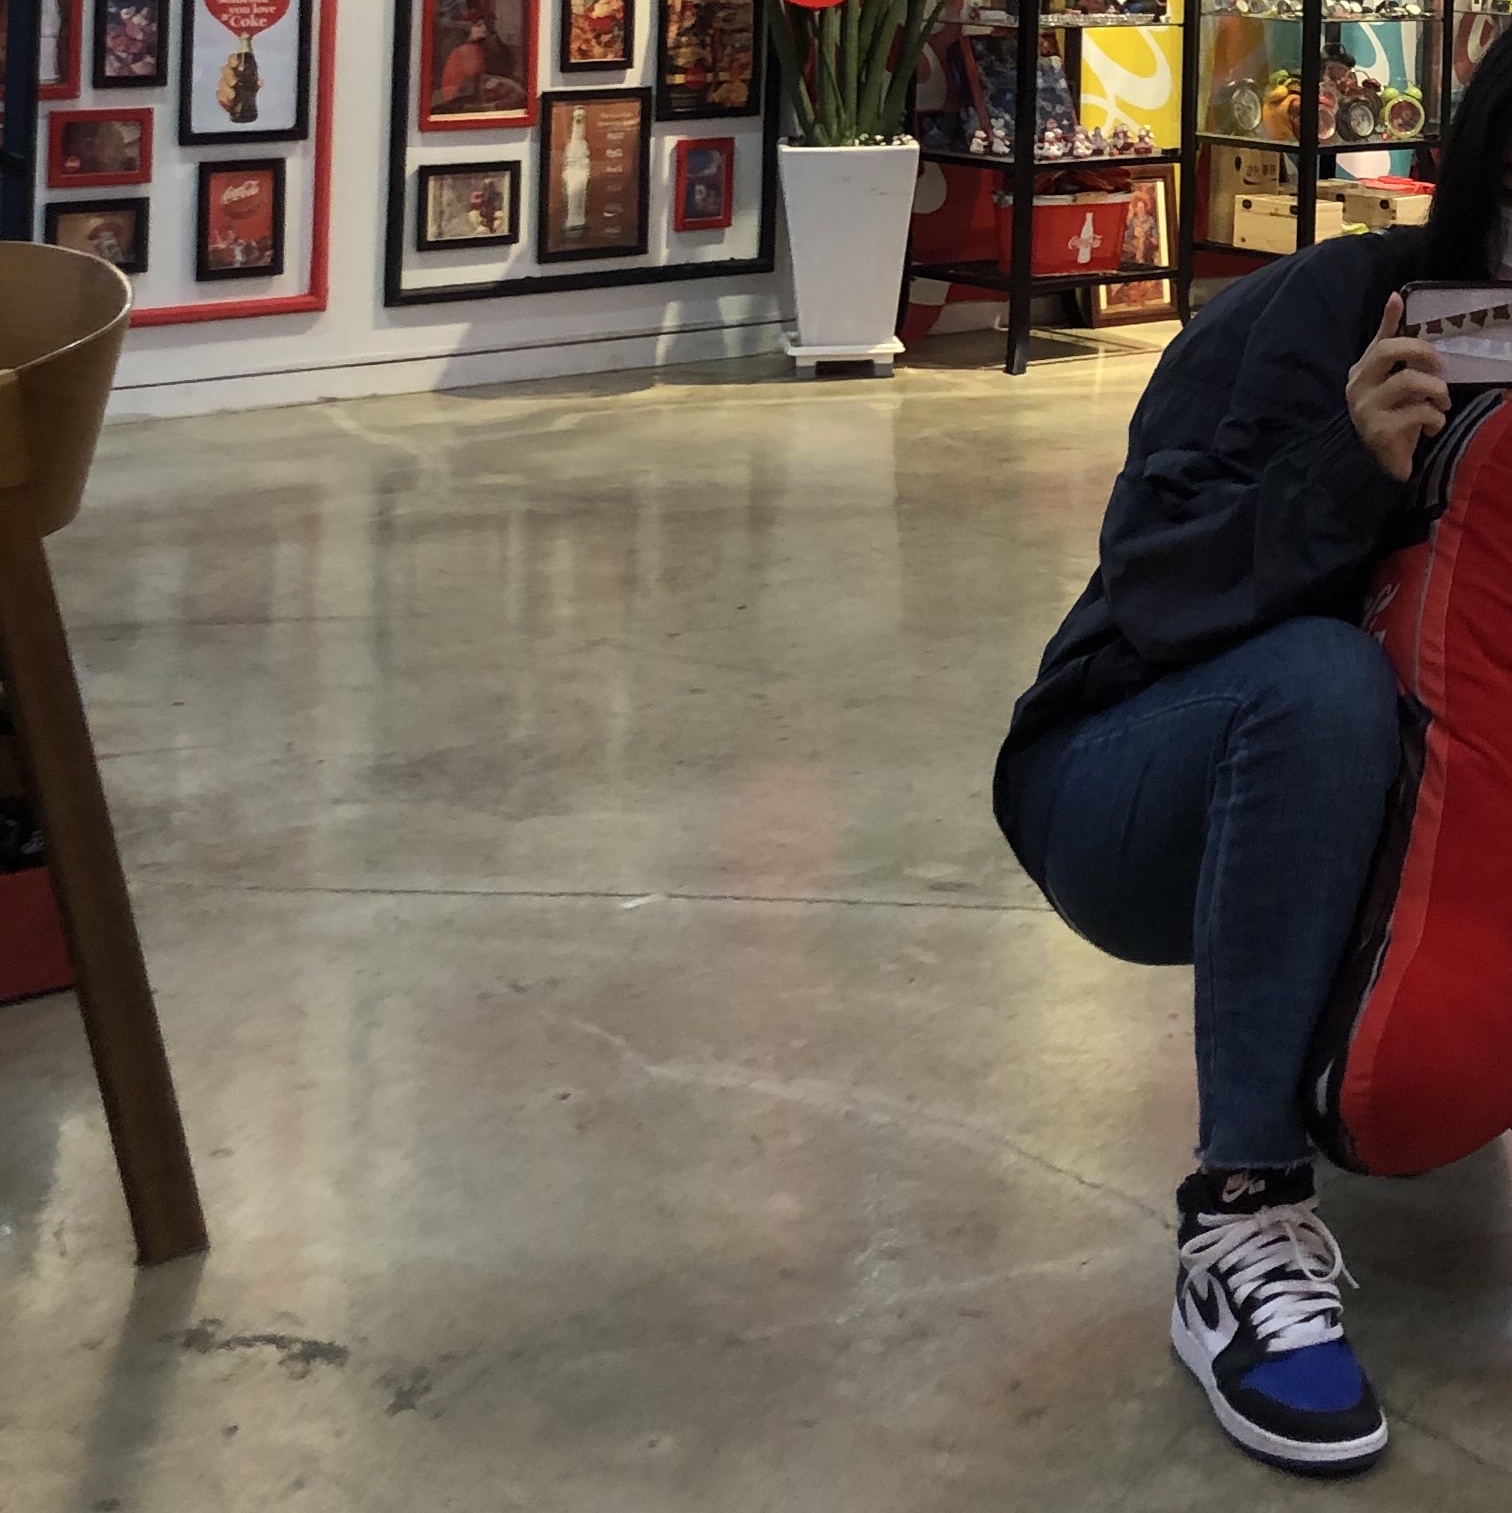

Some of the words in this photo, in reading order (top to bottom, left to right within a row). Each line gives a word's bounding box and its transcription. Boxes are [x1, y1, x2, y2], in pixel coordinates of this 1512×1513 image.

[229, 6, 251, 15] you
[252, 4, 277, 14] love
[229, 14, 268, 27] Coke
